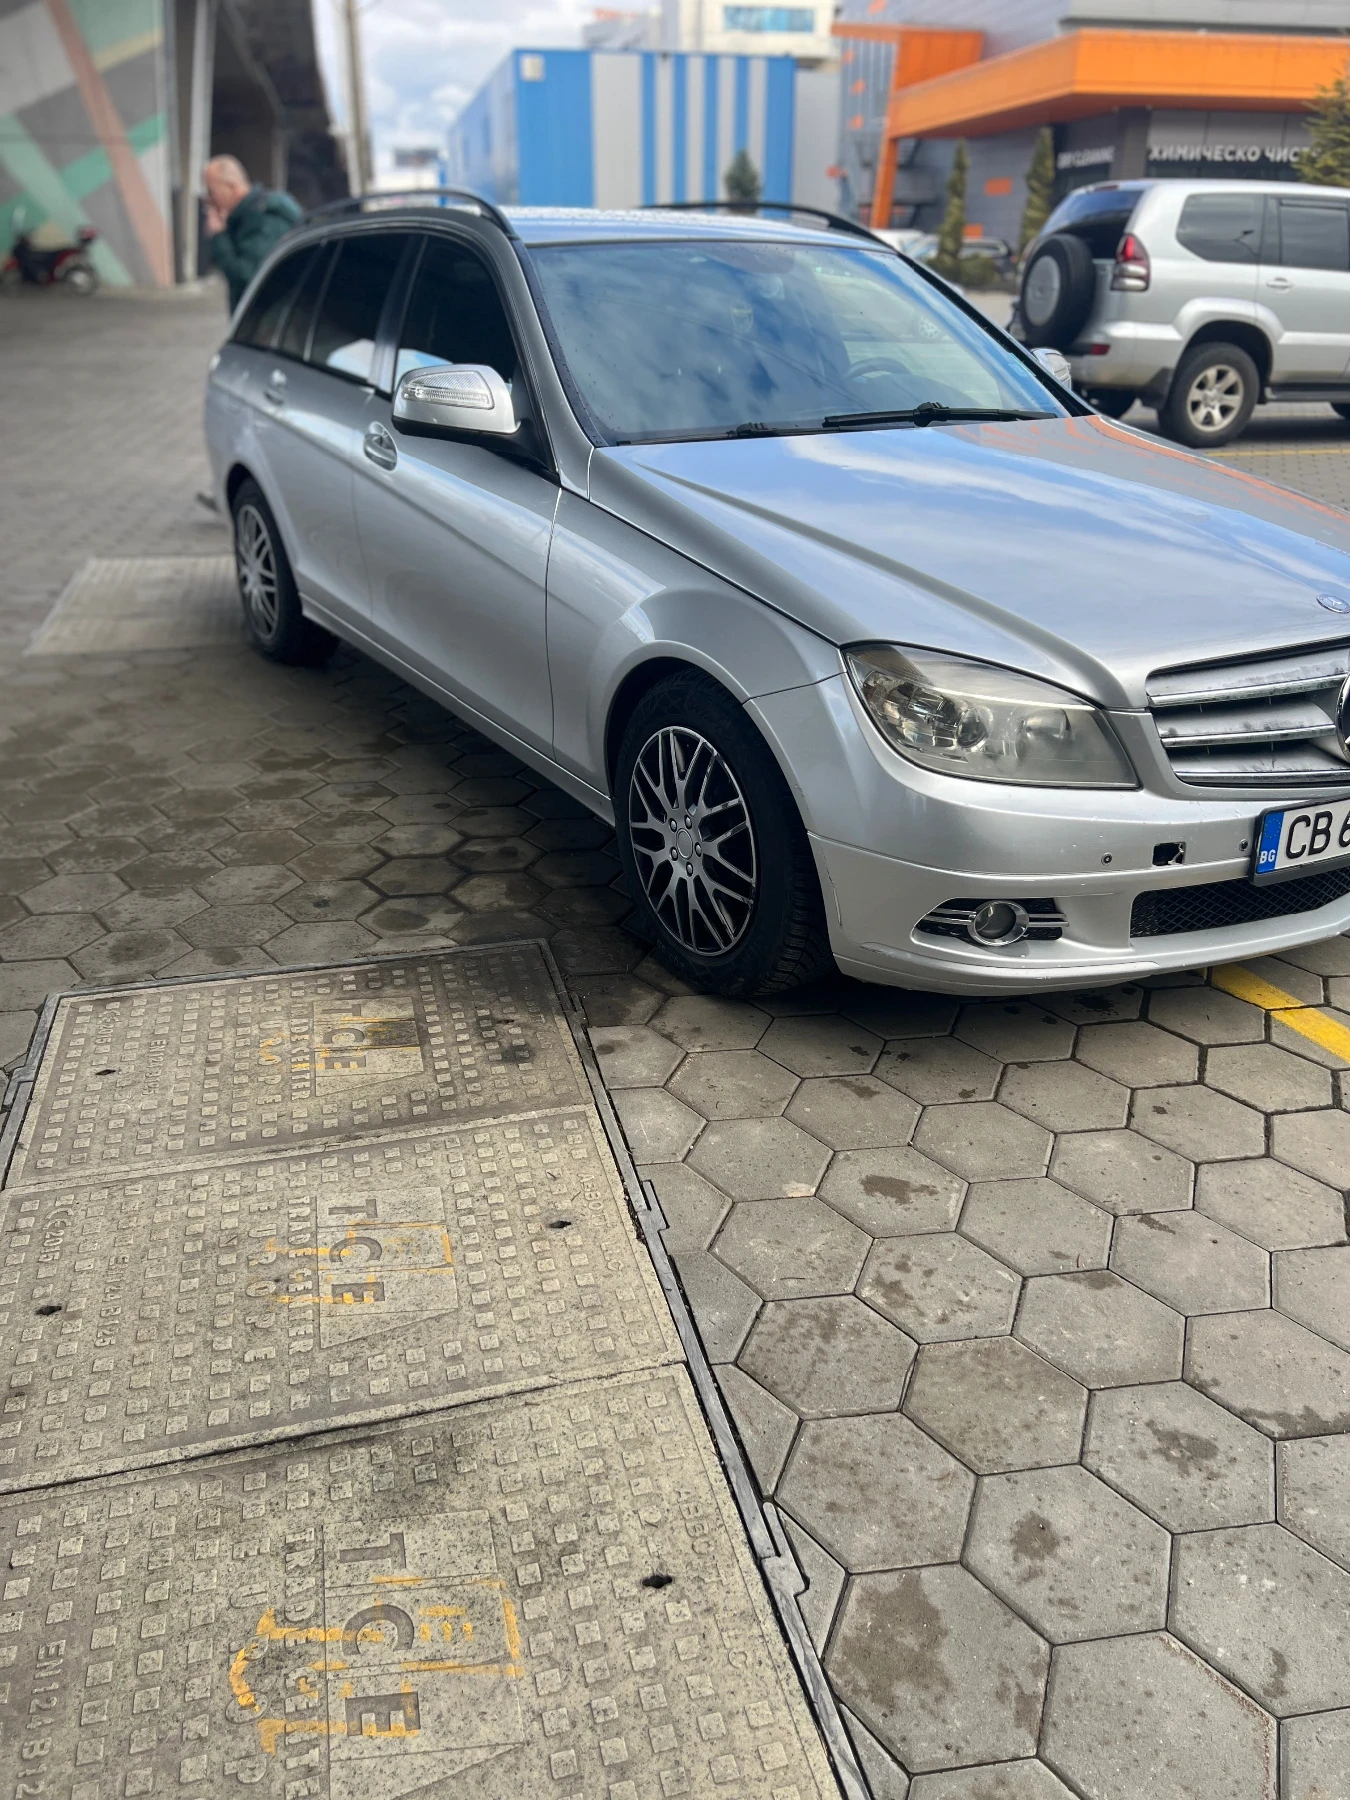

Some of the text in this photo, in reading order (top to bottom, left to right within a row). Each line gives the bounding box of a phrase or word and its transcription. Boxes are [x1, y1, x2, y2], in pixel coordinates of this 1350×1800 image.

[1148, 145, 1260, 163] ХИМИЧЕСКО
[1259, 849, 1276, 864] BG
[1286, 811, 1333, 859] CB
[321, 1003, 367, 1070] TCE
[242, 1201, 278, 1364] EUROPE
[287, 1196, 314, 1356] TRADE CENTER
[327, 1198, 386, 1305] TCE
[283, 1527, 319, 1650] TRADE
[338, 1530, 422, 1738] TCE
